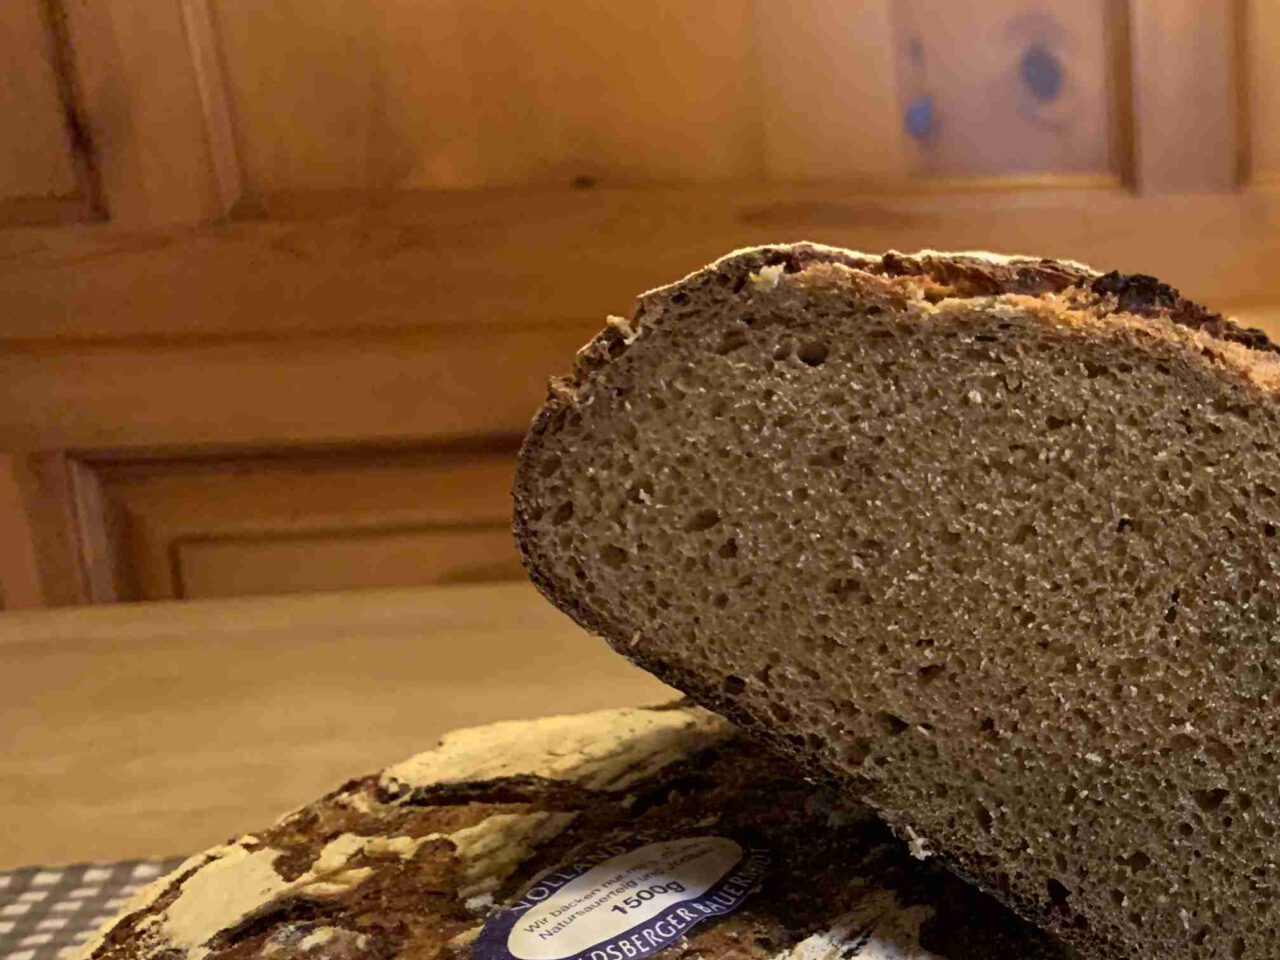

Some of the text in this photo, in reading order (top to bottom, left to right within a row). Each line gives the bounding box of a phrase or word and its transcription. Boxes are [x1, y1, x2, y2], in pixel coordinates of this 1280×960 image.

[538, 878, 639, 941] Natursauerteig
[611, 881, 687, 915] 1500g
[523, 916, 549, 934] Wir
